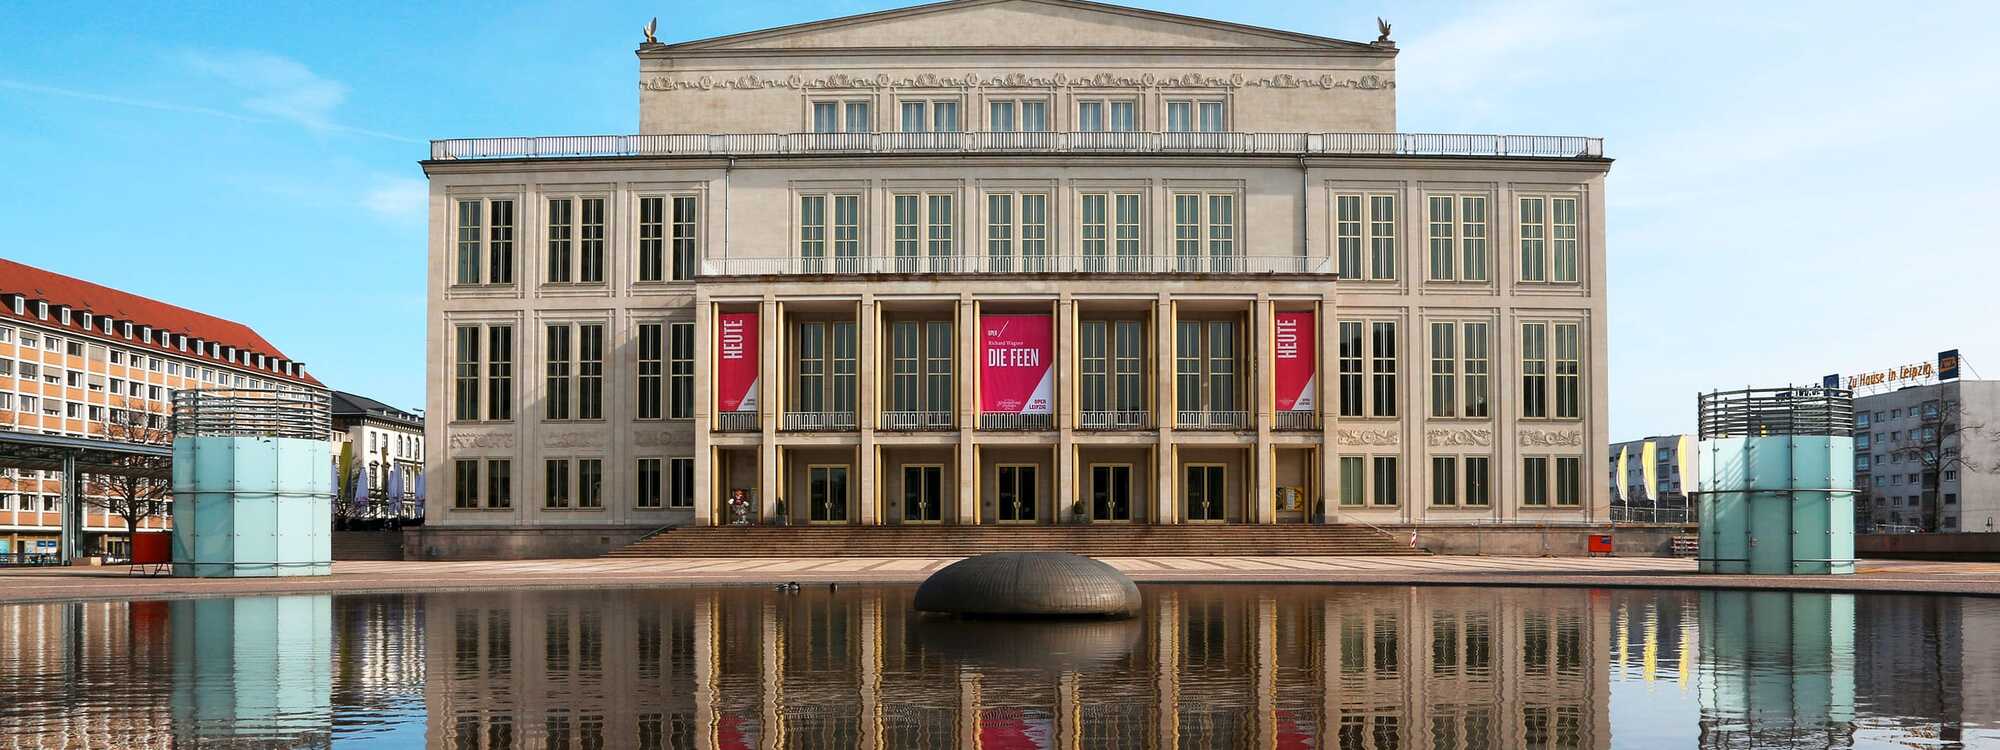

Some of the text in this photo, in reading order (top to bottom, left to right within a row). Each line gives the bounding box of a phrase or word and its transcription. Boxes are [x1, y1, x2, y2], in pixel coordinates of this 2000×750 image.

[723, 319, 743, 359] HEUTE
[1277, 319, 1297, 359] HEUTE
[988, 348, 1039, 367] DIE FEEN
[1848, 375, 1857, 388] Zu
[1888, 368, 1897, 382] in
